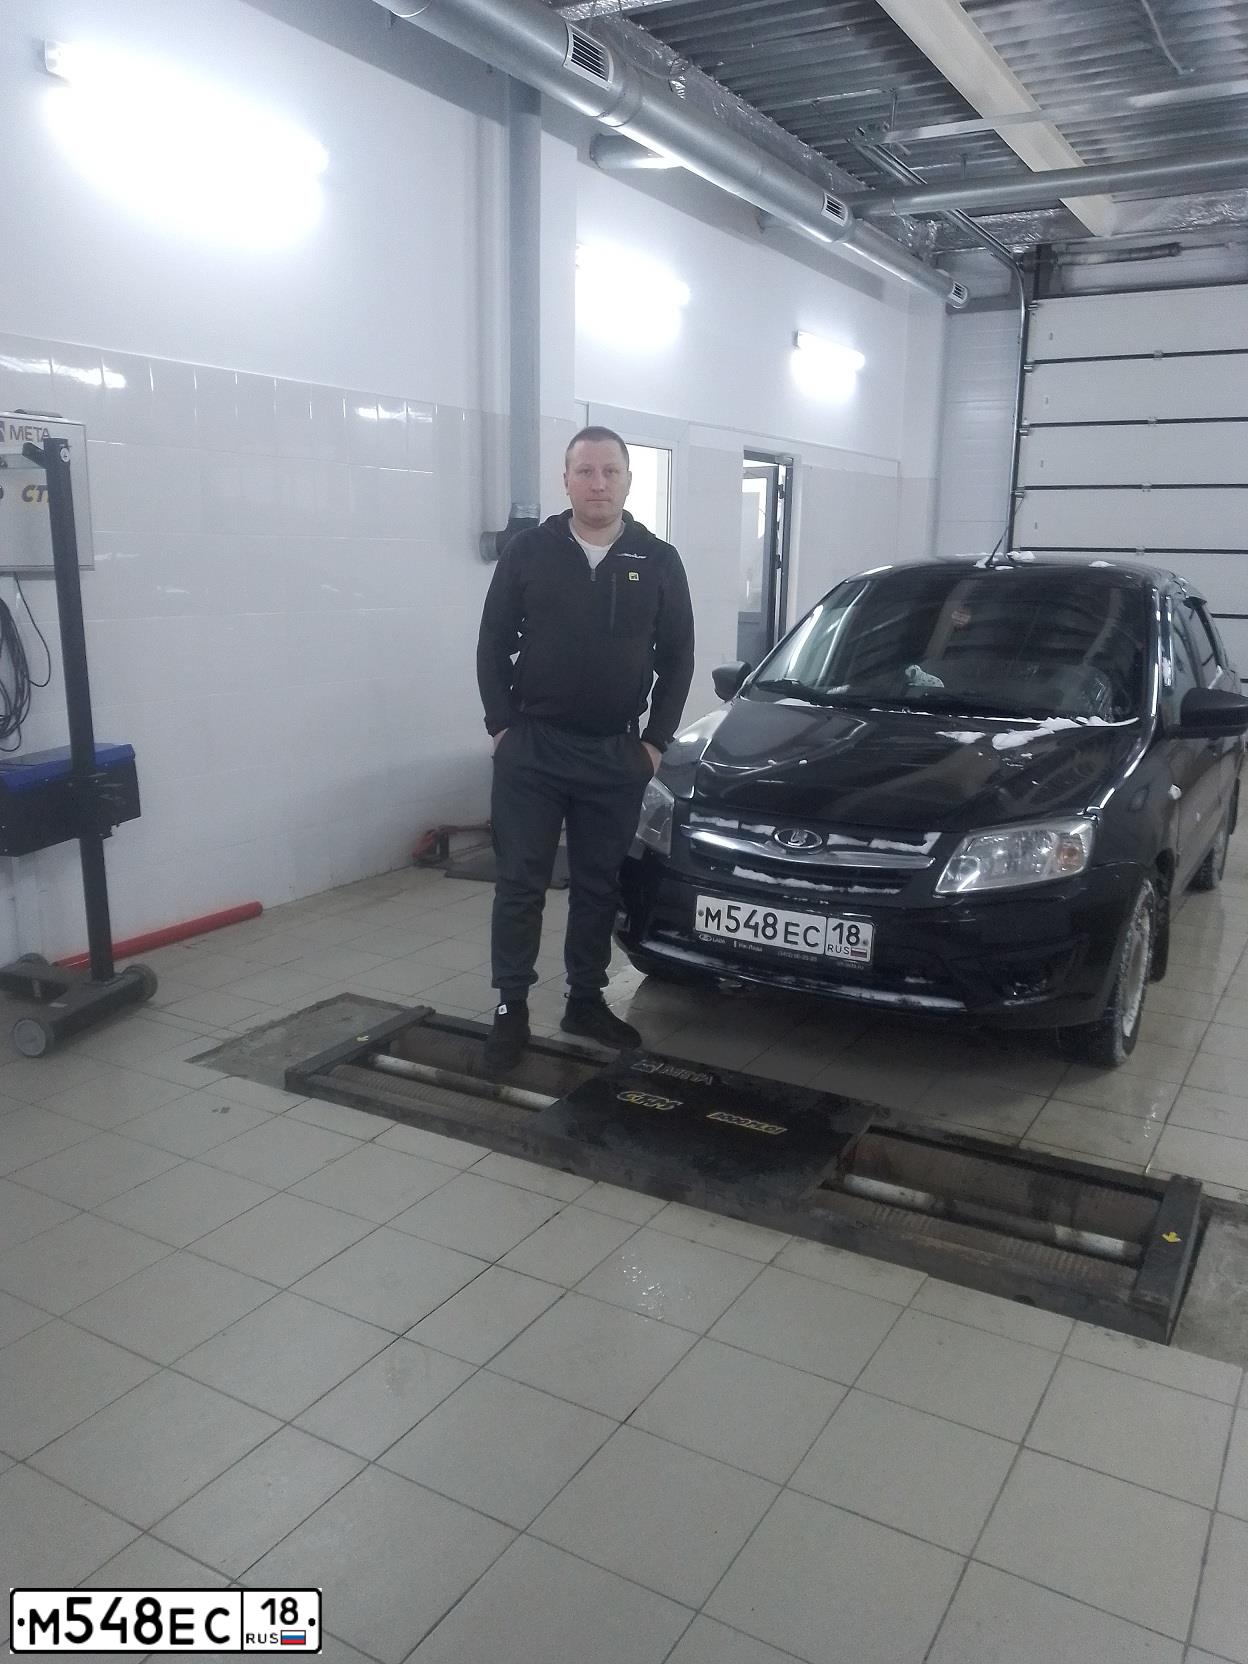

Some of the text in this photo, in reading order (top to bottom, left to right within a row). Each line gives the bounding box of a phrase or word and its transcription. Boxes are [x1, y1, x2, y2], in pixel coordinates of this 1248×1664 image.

[21, 484, 50, 503] СТ
[704, 904, 861, 948] М548ЕС 18
[827, 943, 850, 955] RUS
